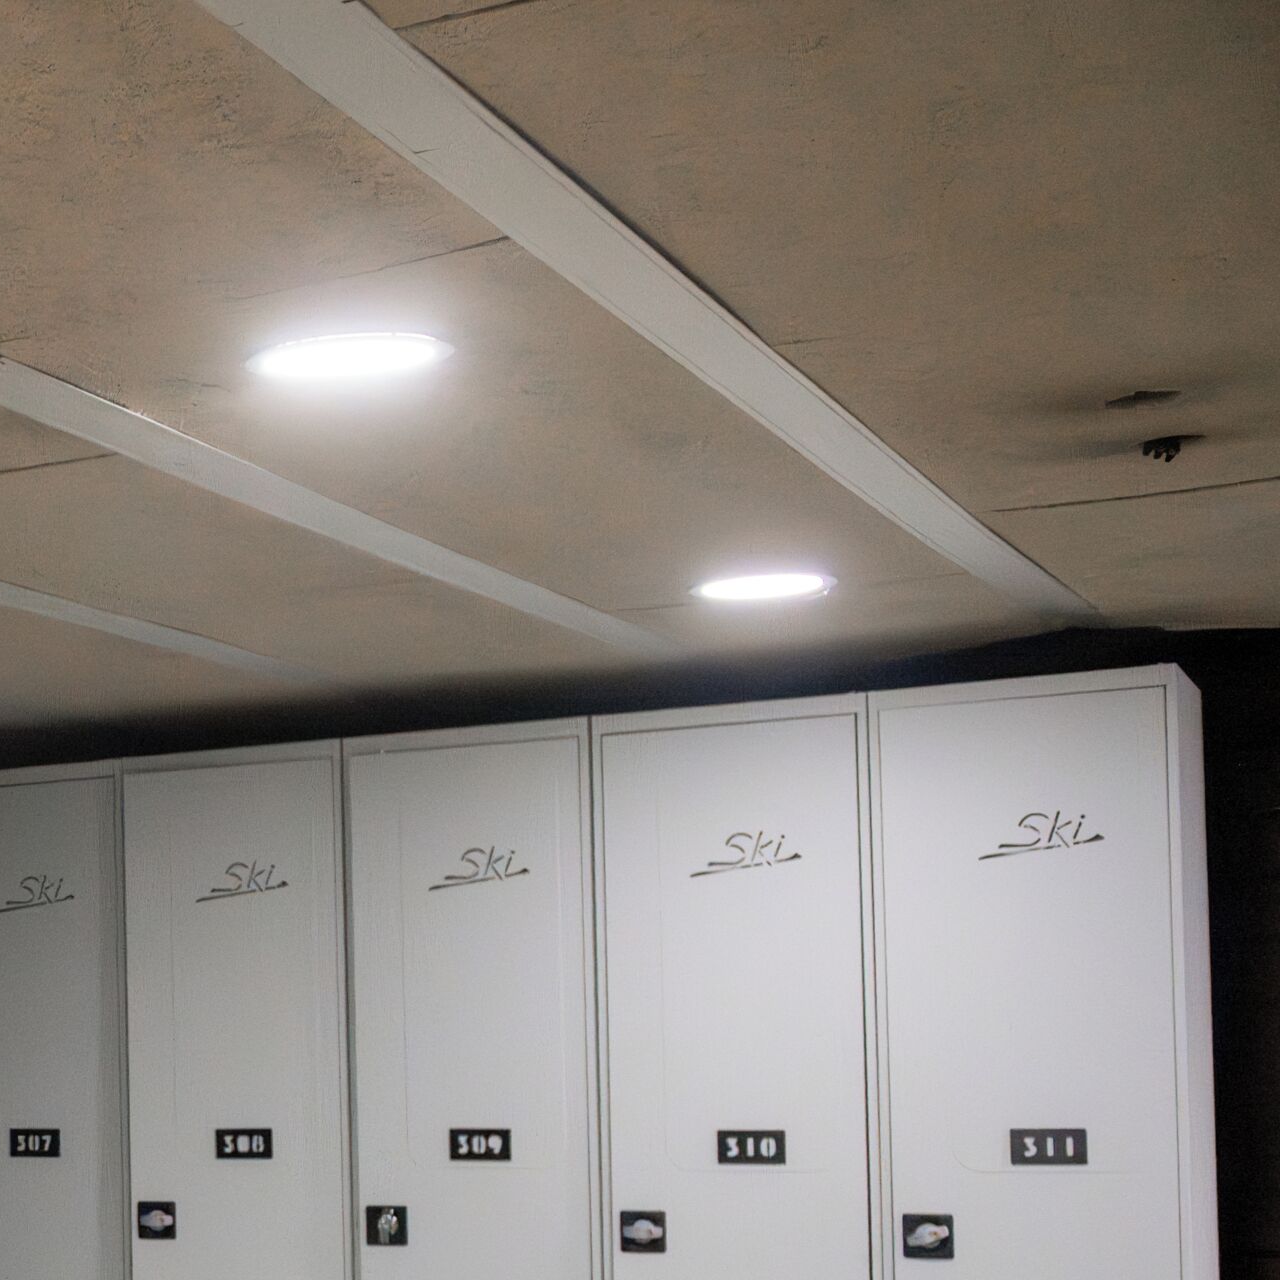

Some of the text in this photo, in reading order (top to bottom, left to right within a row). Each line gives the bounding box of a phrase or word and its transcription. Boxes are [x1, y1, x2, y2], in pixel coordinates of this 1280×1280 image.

[997, 811, 1104, 851] Ski
[441, 846, 529, 882] Ski
[705, 831, 801, 869] Ski
[4, 875, 74, 908] Ski
[209, 861, 288, 894] Ski
[16, 1134, 52, 1152] 307
[457, 1134, 503, 1155] 309
[726, 1136, 777, 1158] 310
[1023, 1136, 1074, 1158] 311
